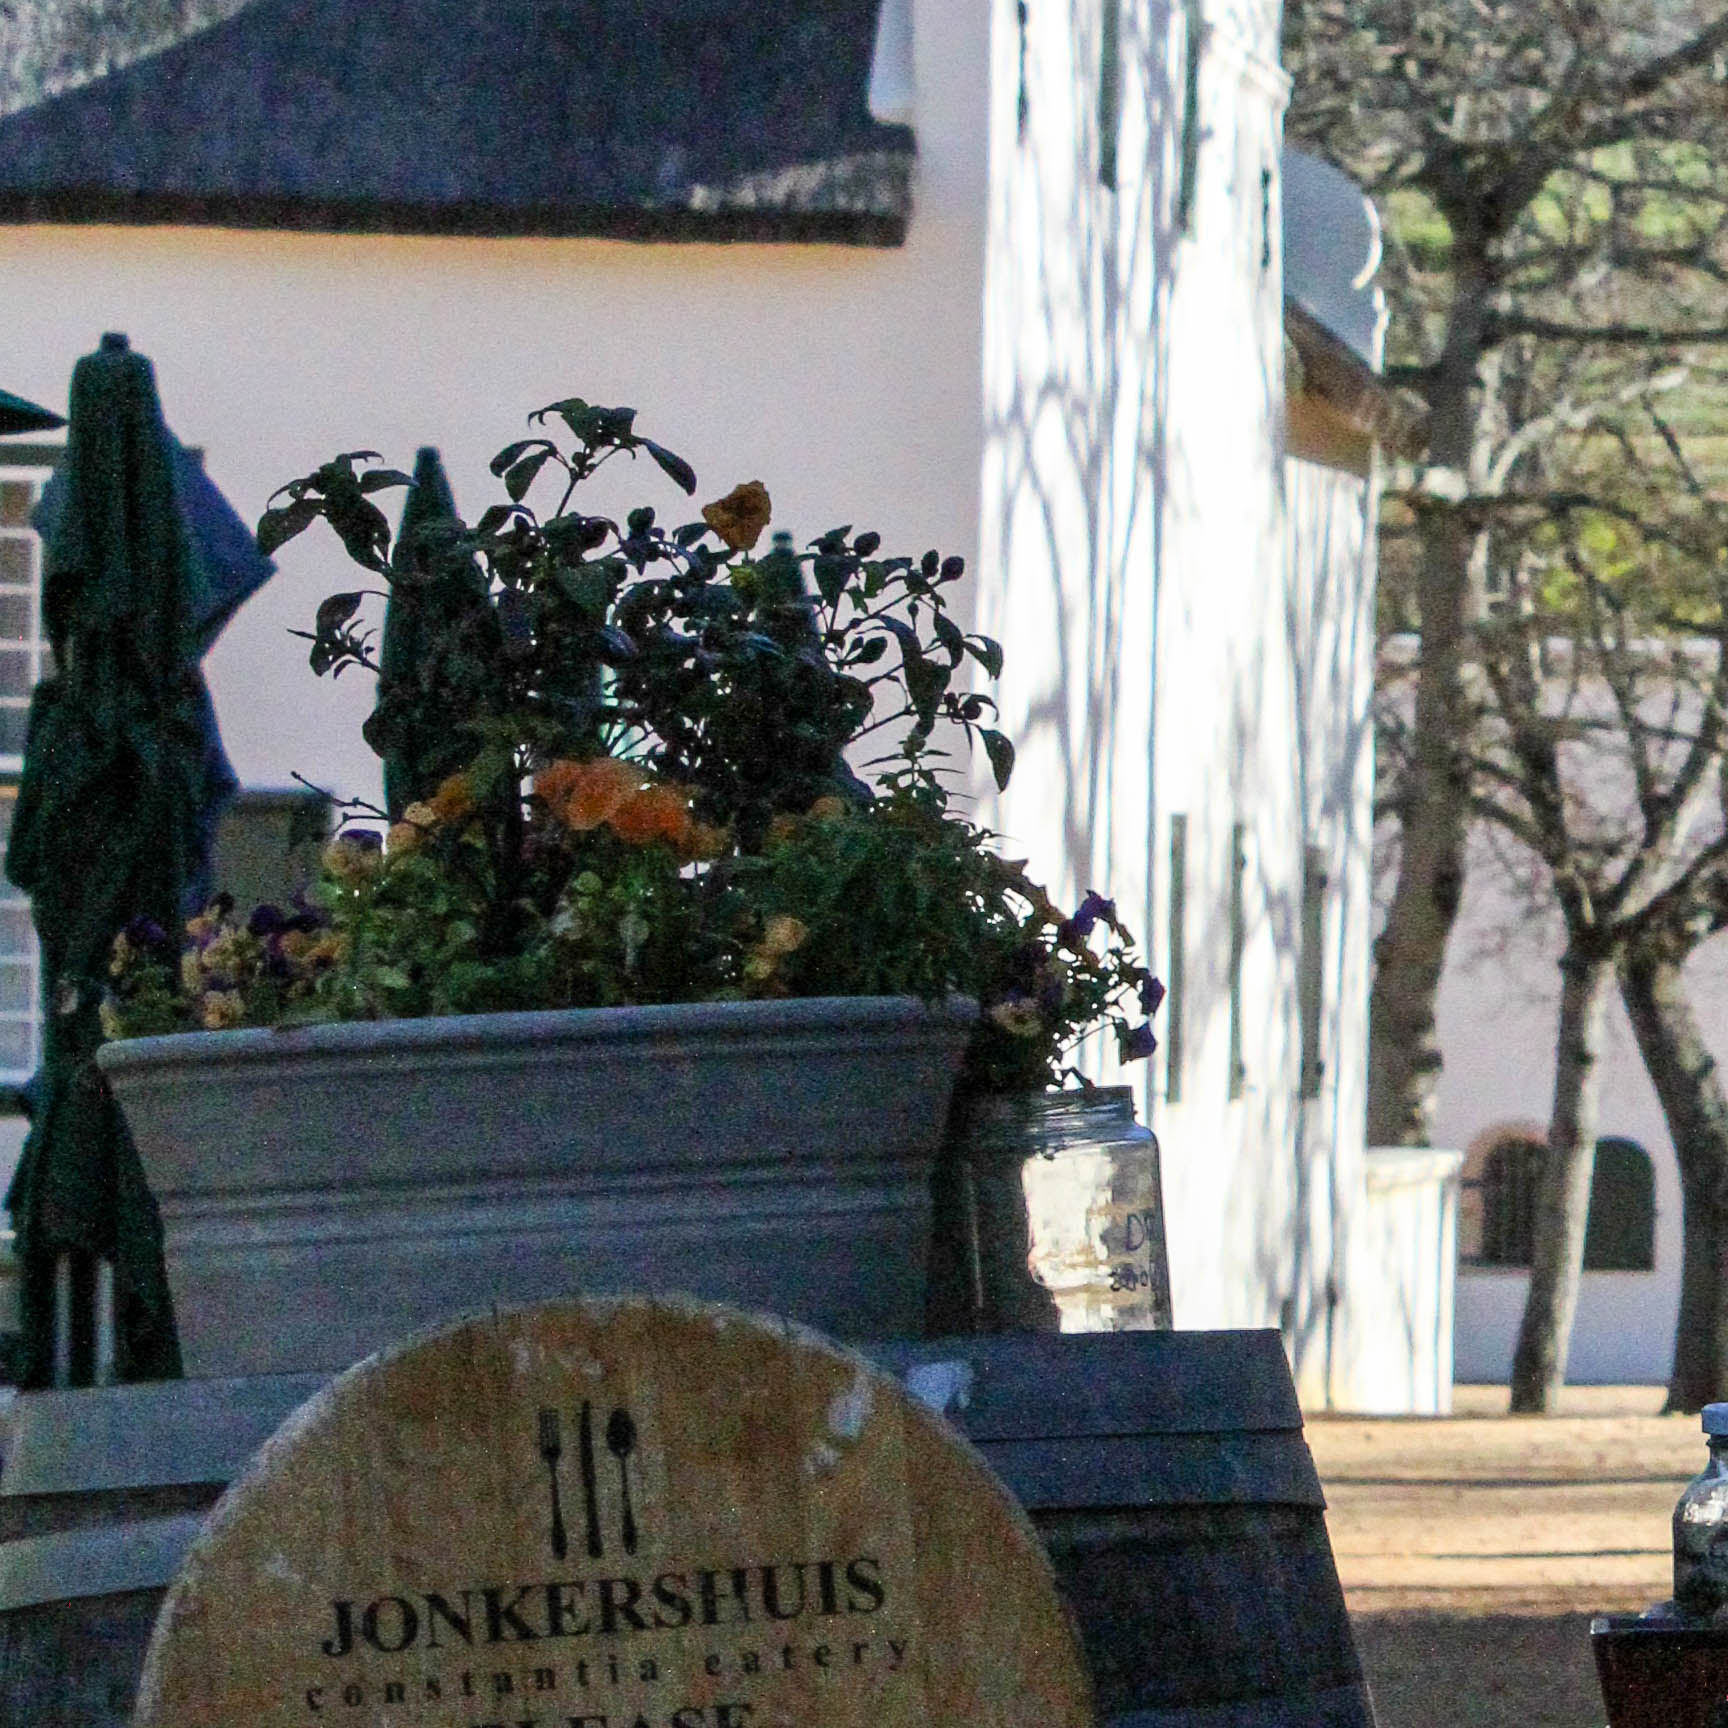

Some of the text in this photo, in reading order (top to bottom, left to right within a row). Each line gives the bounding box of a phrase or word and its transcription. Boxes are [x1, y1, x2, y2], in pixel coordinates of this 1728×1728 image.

[320, 1557, 887, 1659] JONKERSHUIS
[304, 1634, 911, 1712] constantia eatery
